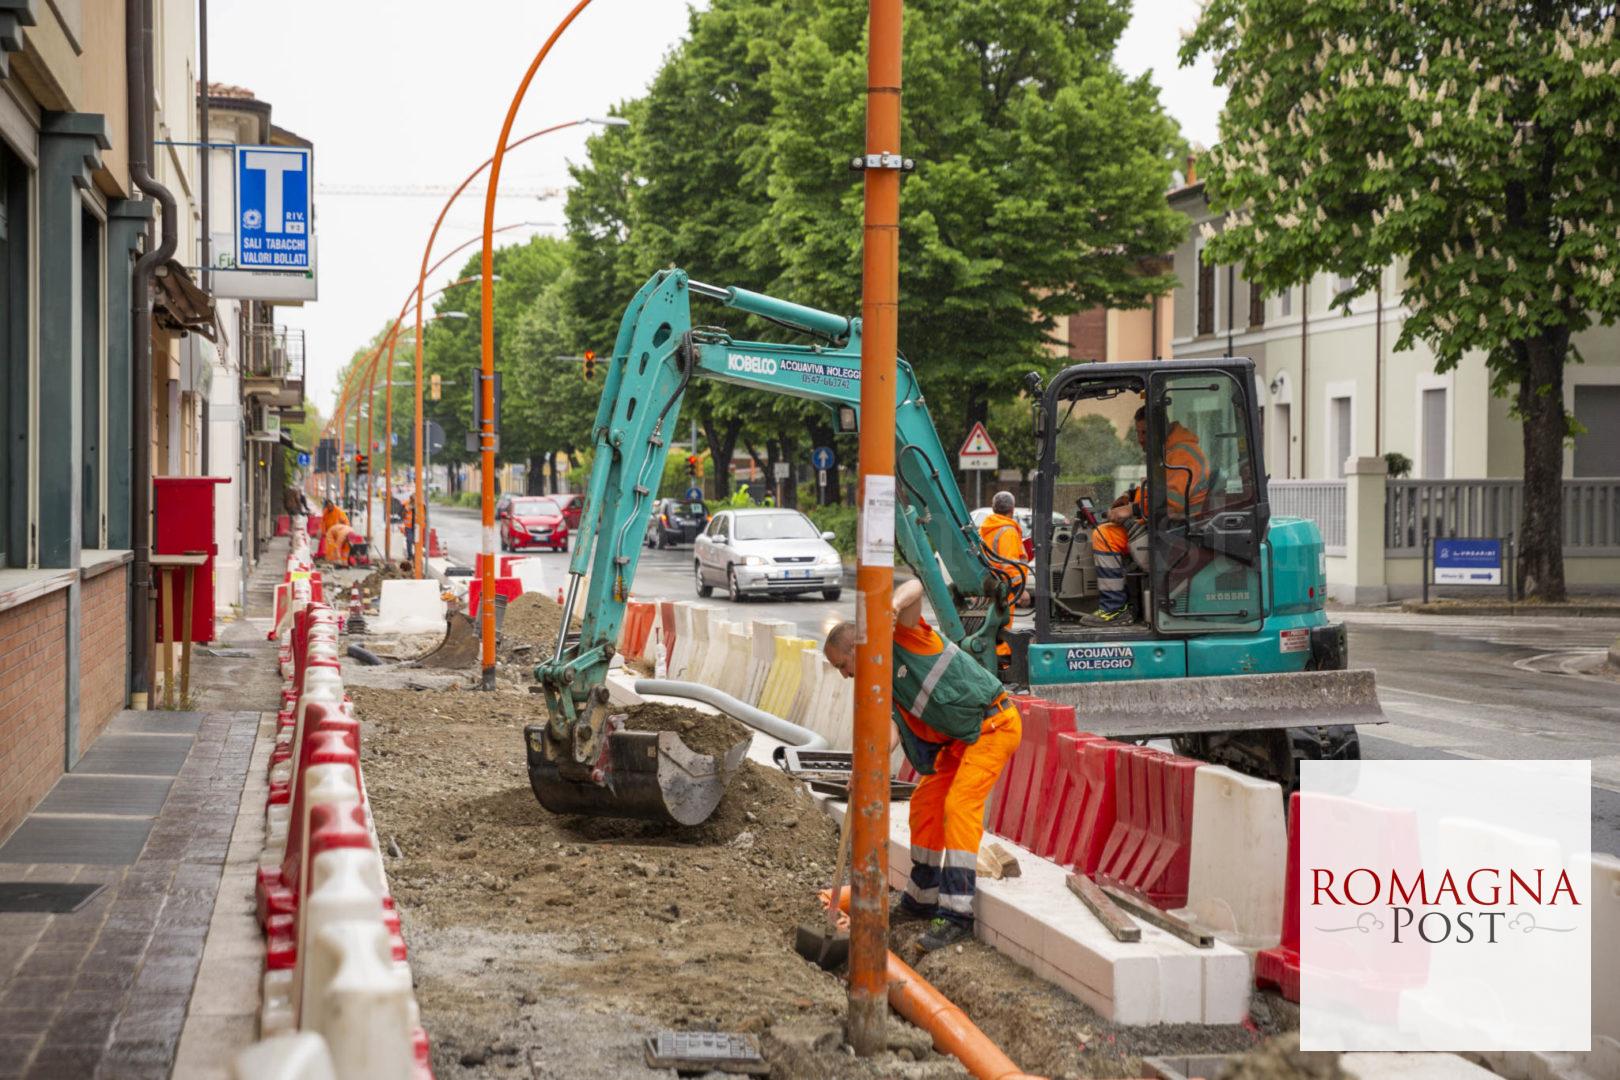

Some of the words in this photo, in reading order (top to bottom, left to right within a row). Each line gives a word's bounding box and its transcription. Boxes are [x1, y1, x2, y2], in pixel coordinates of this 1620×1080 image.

[245, 151, 303, 233] T
[285, 211, 304, 221] RIV.
[243, 238, 262, 249] SALI
[266, 239, 305, 250] TABACCHI
[243, 251, 272, 263] VALORI
[274, 252, 307, 265] BOLLATI
[728, 354, 777, 375] KOBELCO
[780, 359, 824, 375] ACQUAVIVA
[827, 366, 861, 380] NOLEGGI
[1067, 647, 1133, 659] ACQUAVIVA
[1069, 659, 1132, 670] NOLEGGIO
